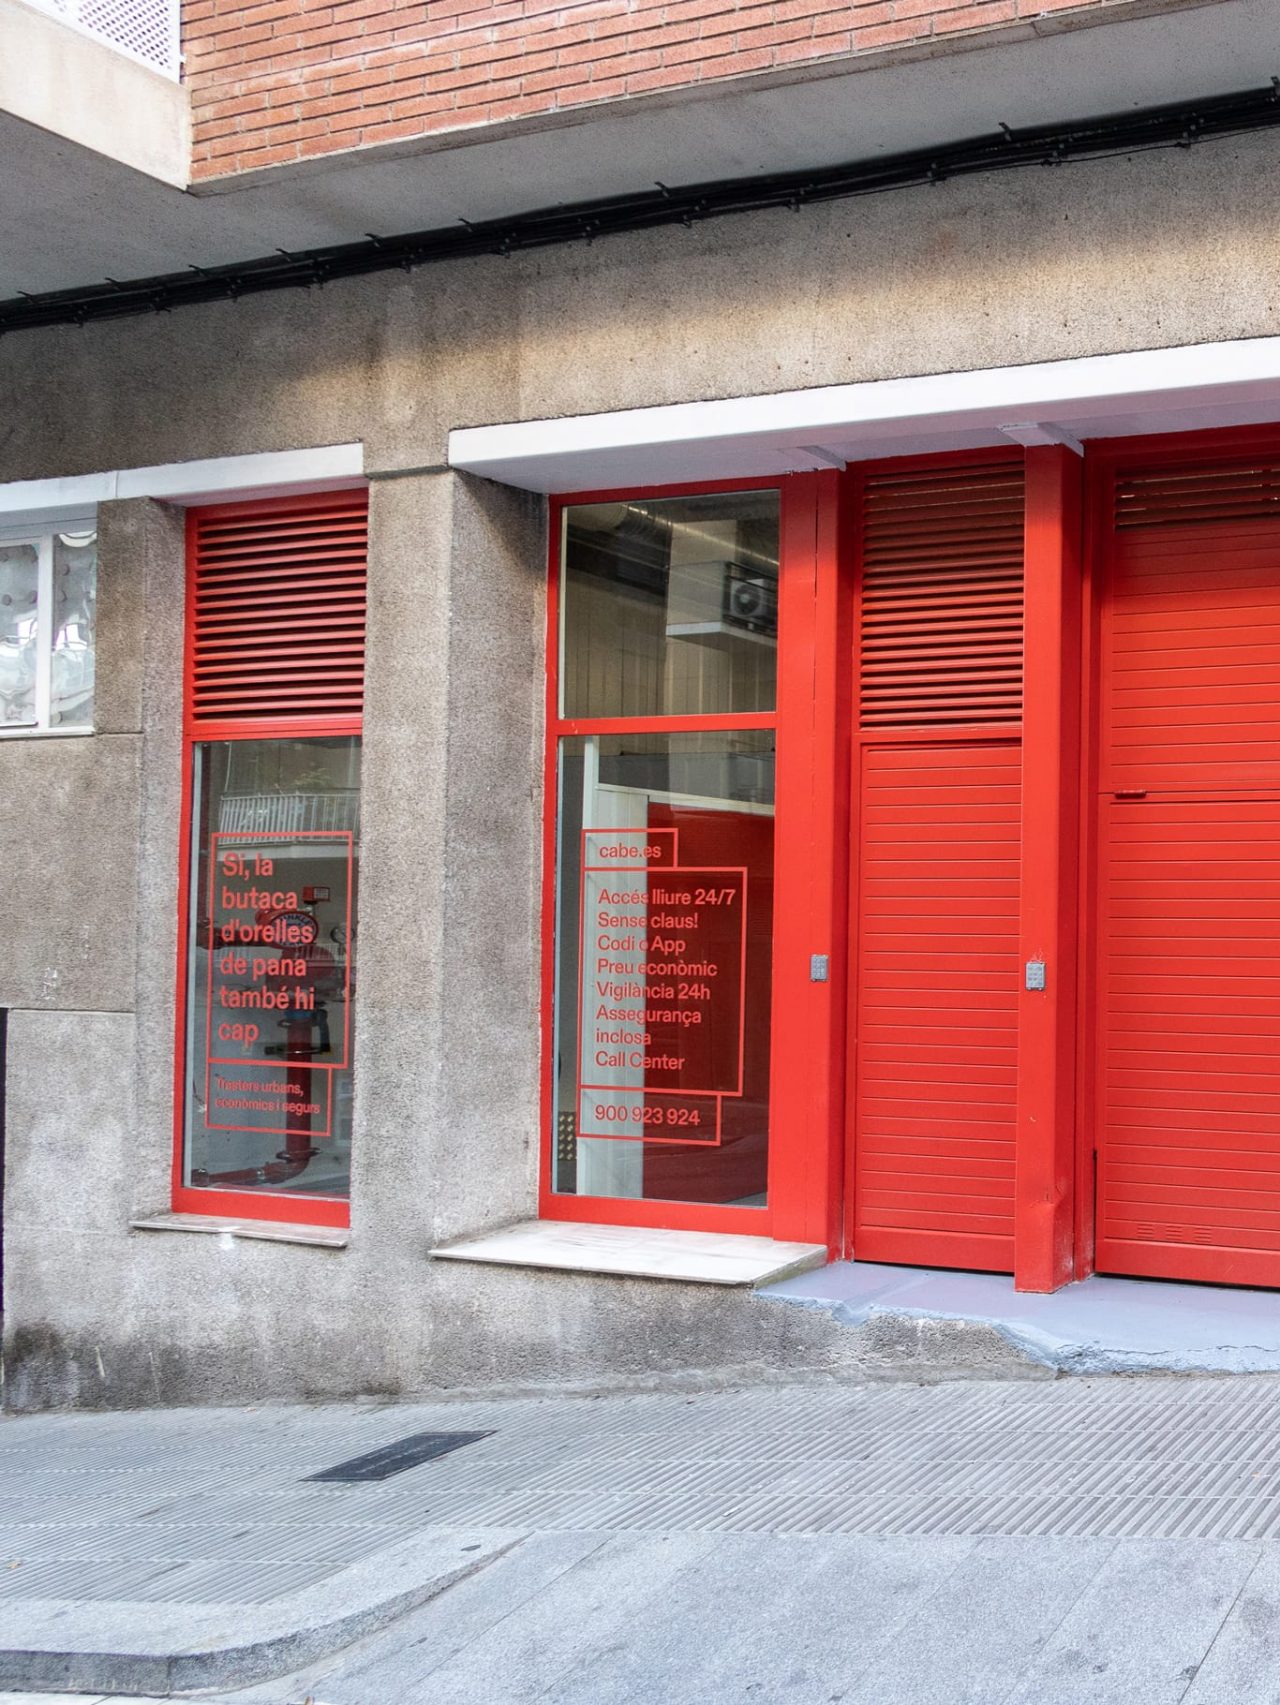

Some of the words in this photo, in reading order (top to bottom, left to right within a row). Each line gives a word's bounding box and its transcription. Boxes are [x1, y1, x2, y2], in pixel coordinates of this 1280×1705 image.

[599, 842, 662, 858] cabe.es
[255, 853, 273, 876] la
[222, 886, 298, 909] butaca
[598, 888, 649, 905] Accés
[652, 889, 692, 905] lliure
[695, 889, 736, 905] 24/7
[598, 912, 647, 928] Sense
[651, 912, 699, 928] claus!
[221, 919, 314, 943] d'orelles
[597, 934, 635, 951] Codi
[639, 940, 649, 951] o
[650, 935, 687, 956] App
[220, 951, 248, 975] de
[253, 957, 307, 981] pana
[597, 958, 634, 974] Preu
[638, 960, 718, 977] econòmic
[220, 985, 290, 1009] també
[295, 986, 315, 1010] hi
[596, 981, 674, 1002] Vigilància
[678, 983, 711, 1000] 24h
[596, 1004, 702, 1028] Assegurança
[218, 1022, 260, 1048] cap
[596, 1027, 652, 1045] inclosa
[595, 1050, 626, 1067] Call
[629, 1051, 686, 1070] Center
[261, 1080, 304, 1097] urbans,
[282, 1103, 320, 1116] segurs
[595, 1104, 628, 1121] 900
[632, 1106, 663, 1124] 923
[666, 1108, 701, 1126] 924
